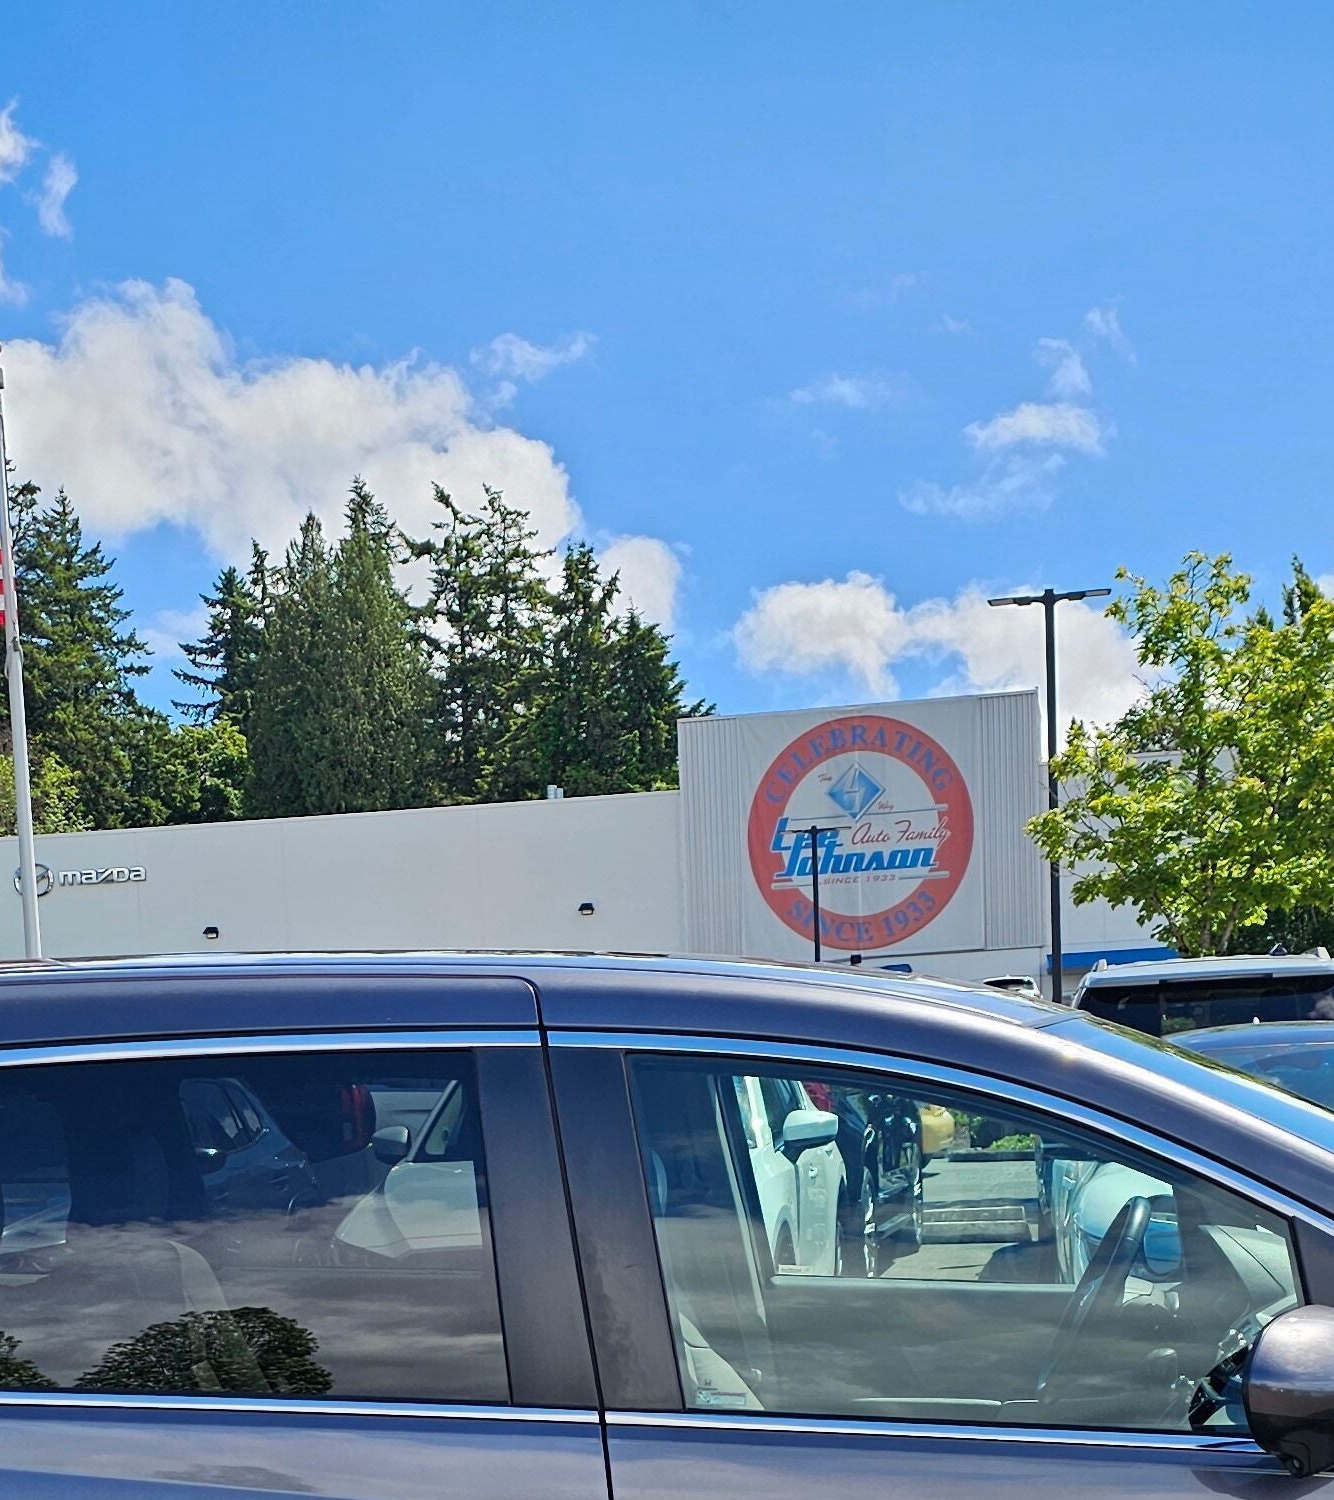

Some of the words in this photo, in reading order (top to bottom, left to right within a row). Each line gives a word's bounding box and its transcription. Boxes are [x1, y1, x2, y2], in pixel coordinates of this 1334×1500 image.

[765, 724, 954, 804] CELEBRATING
[771, 817, 844, 852] Lee
[851, 822, 891, 846] Auto
[894, 816, 951, 848] Family
[773, 835, 938, 879] Johnson
[822, 876, 860, 886] SINCE
[866, 874, 897, 883] 1933
[787, 900, 874, 943] SINCE
[880, 890, 936, 937] 1933
